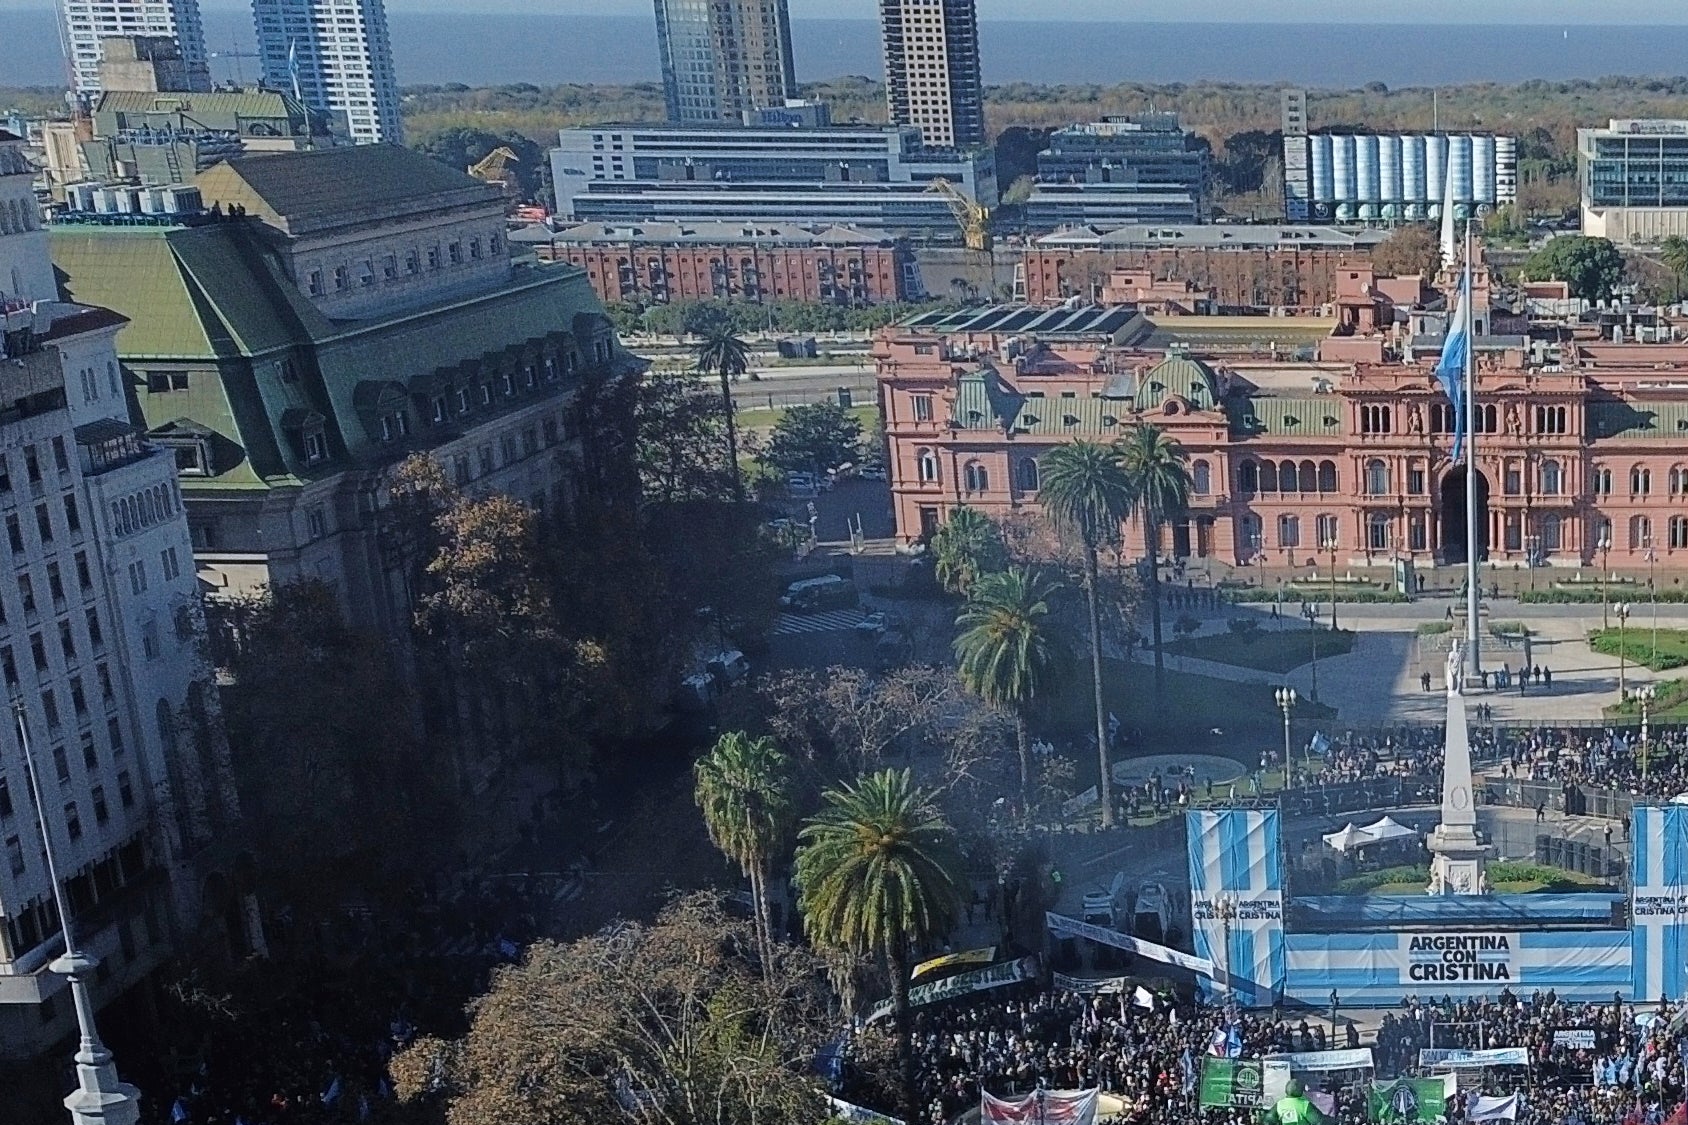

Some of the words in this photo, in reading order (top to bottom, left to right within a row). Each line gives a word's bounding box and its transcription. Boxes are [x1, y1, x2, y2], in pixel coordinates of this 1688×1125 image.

[1239, 900, 1280, 908] ARGENTINA
[1239, 912, 1281, 920] CRISTINA
[1634, 907, 1675, 916] CRISTINA
[1409, 935, 1510, 950] ARGENTINA
[1442, 950, 1477, 963] CON
[1408, 963, 1510, 981] CRISTINA
